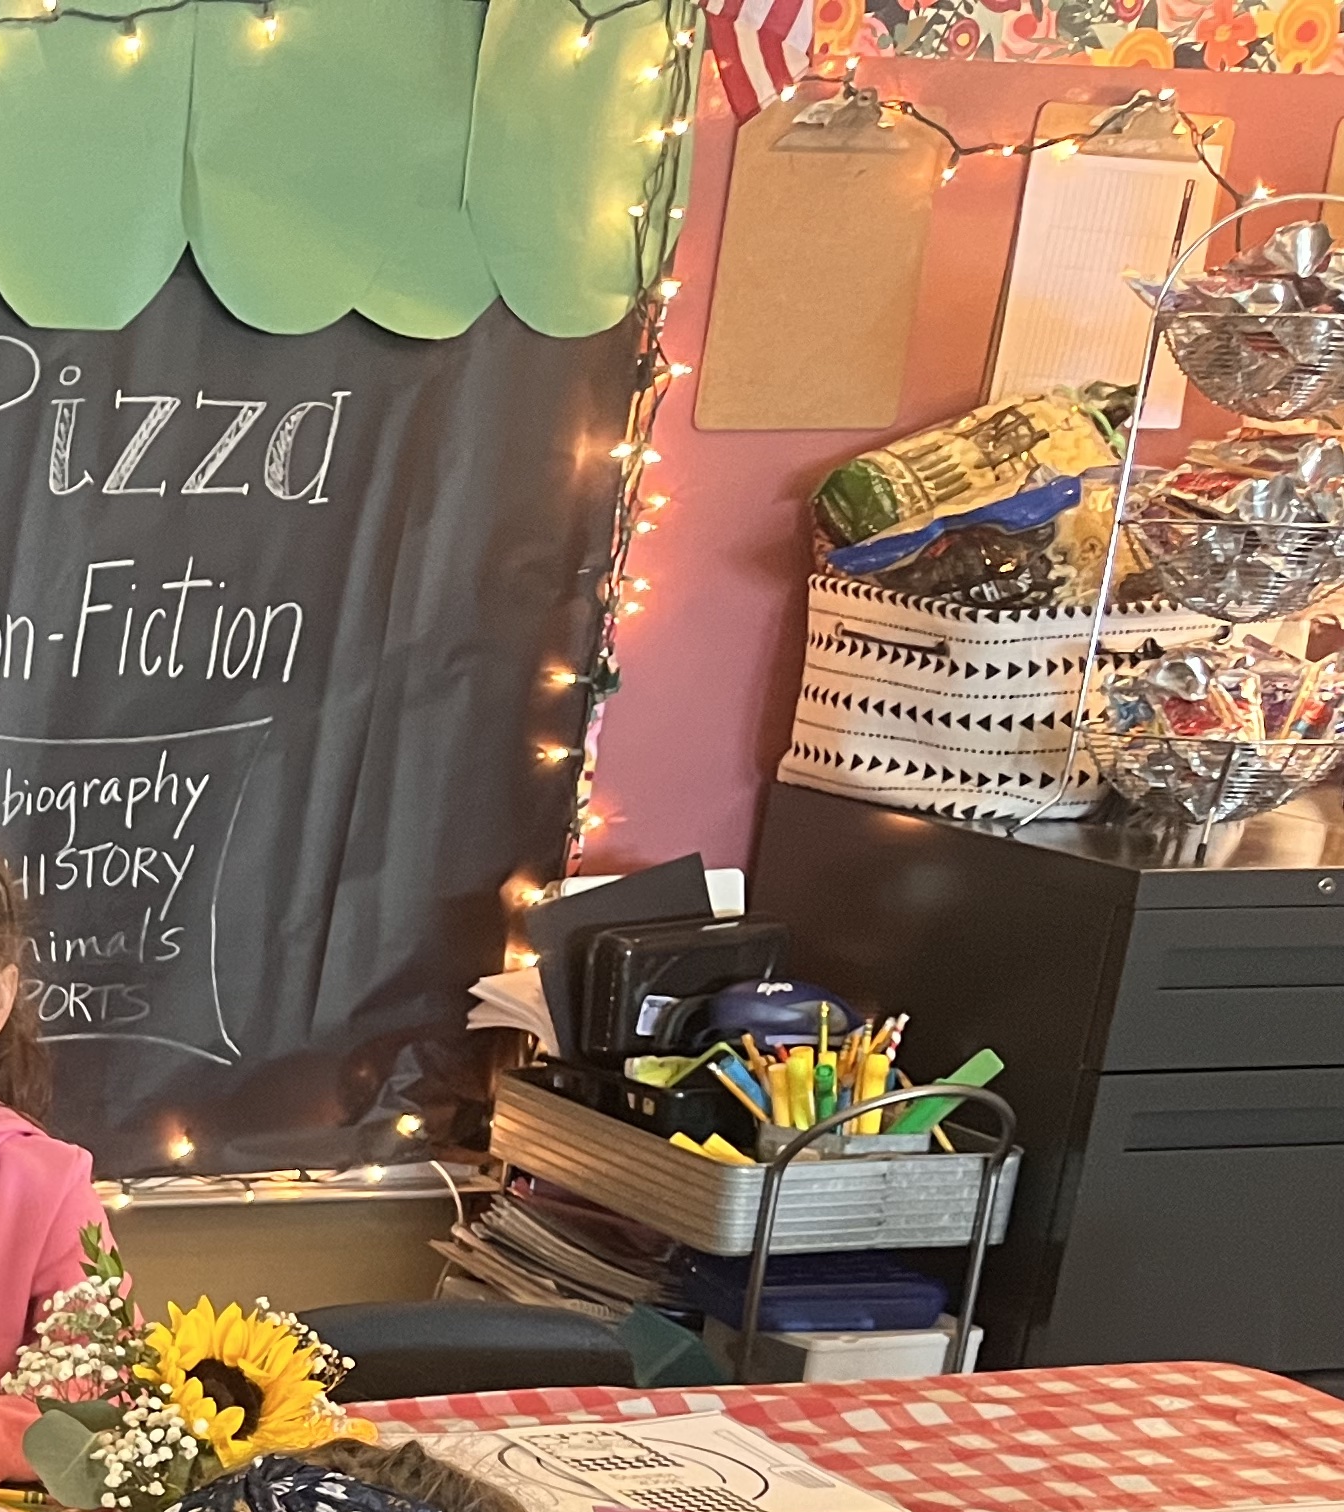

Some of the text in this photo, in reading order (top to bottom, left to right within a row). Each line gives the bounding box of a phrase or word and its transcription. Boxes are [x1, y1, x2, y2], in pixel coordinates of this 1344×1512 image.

[2, 749, 210, 850] biography
[16, 906, 186, 963] nimals
[18, 976, 151, 1023] PORTS
